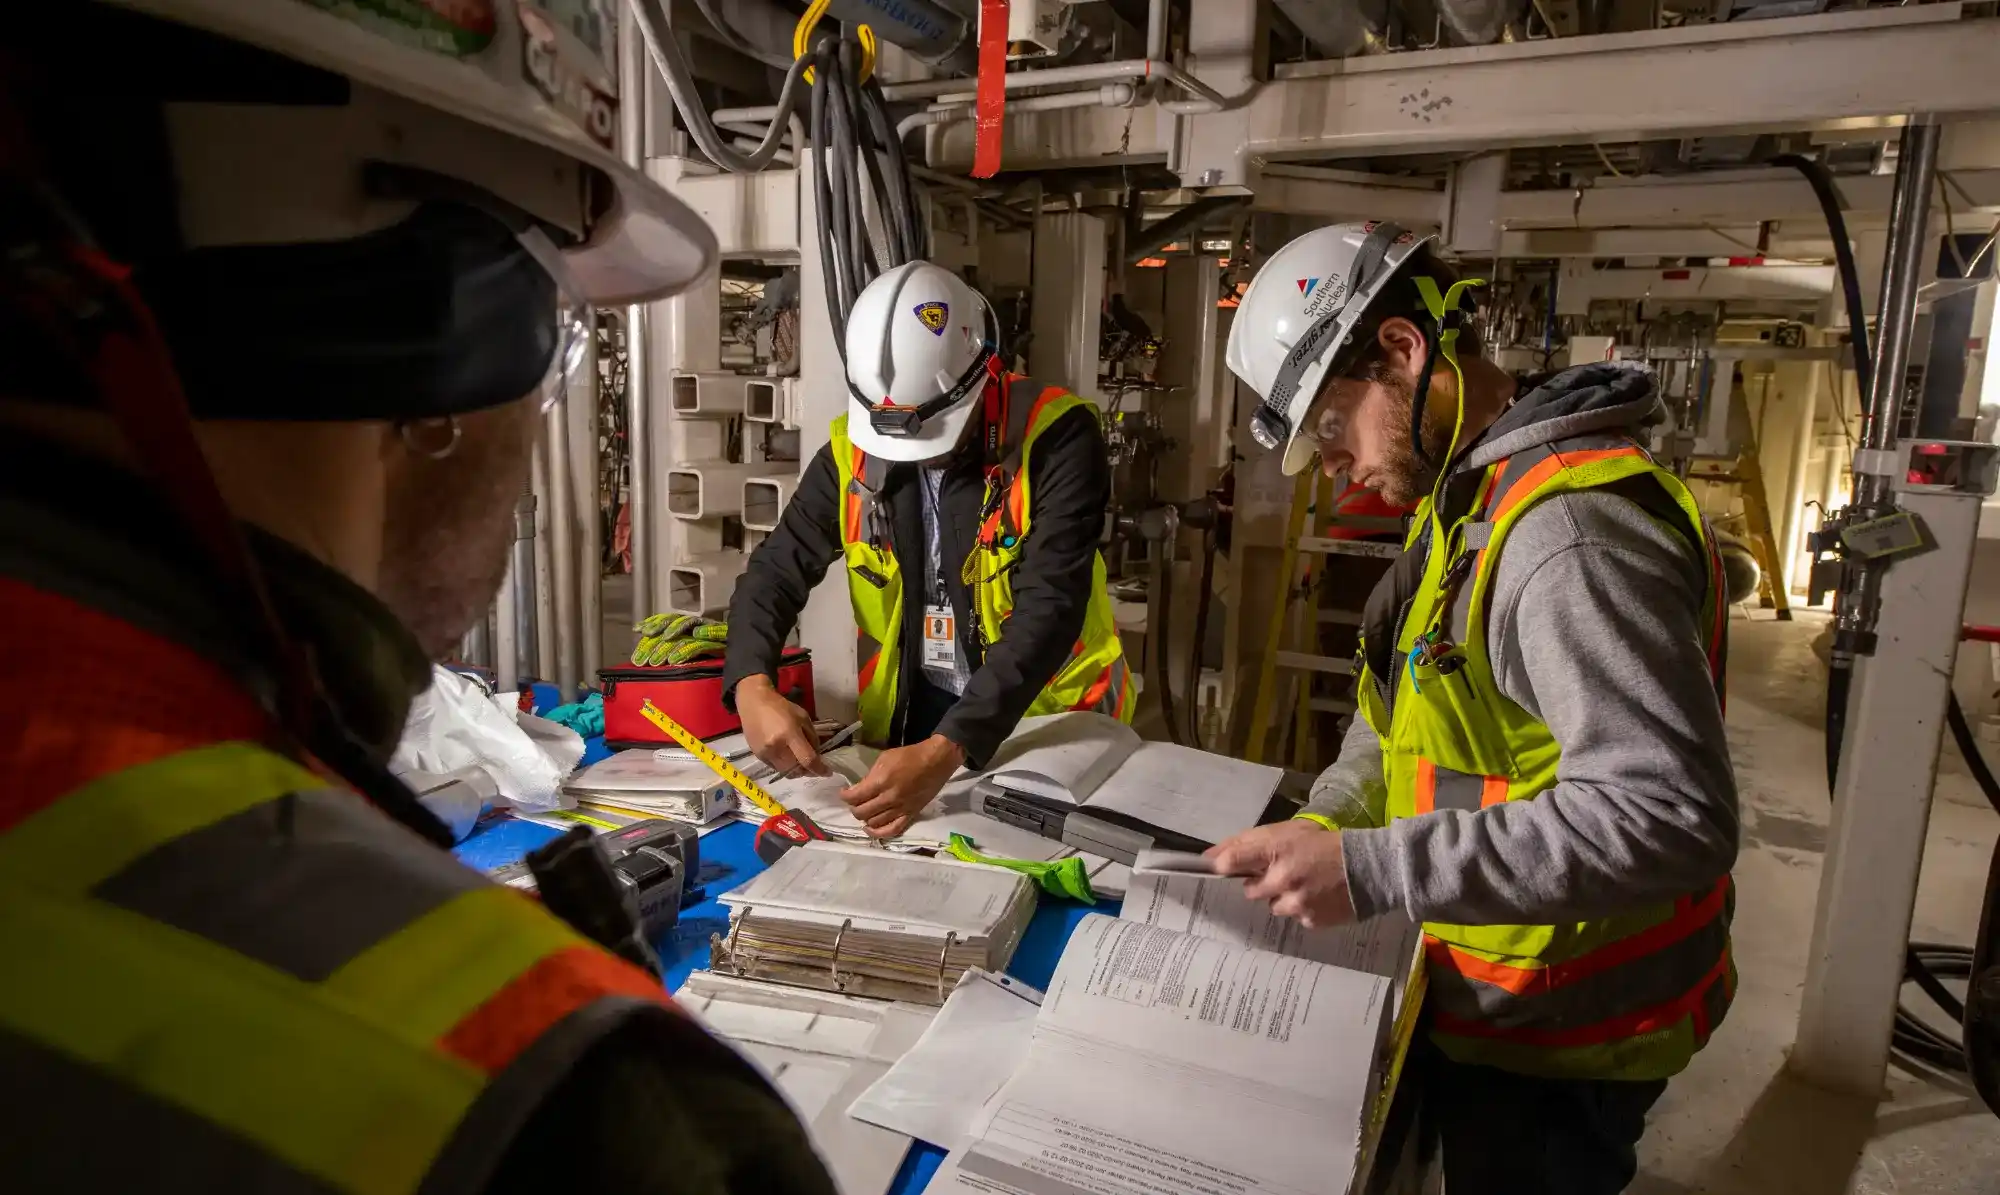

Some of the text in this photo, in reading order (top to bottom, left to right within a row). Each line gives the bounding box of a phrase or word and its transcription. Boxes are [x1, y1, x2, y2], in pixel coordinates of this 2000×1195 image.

[1304, 272, 1340, 318] Southern
[1316, 281, 1348, 318] Nuclear
[745, 780, 753, 790] 10
[756, 789, 764, 799] 11
